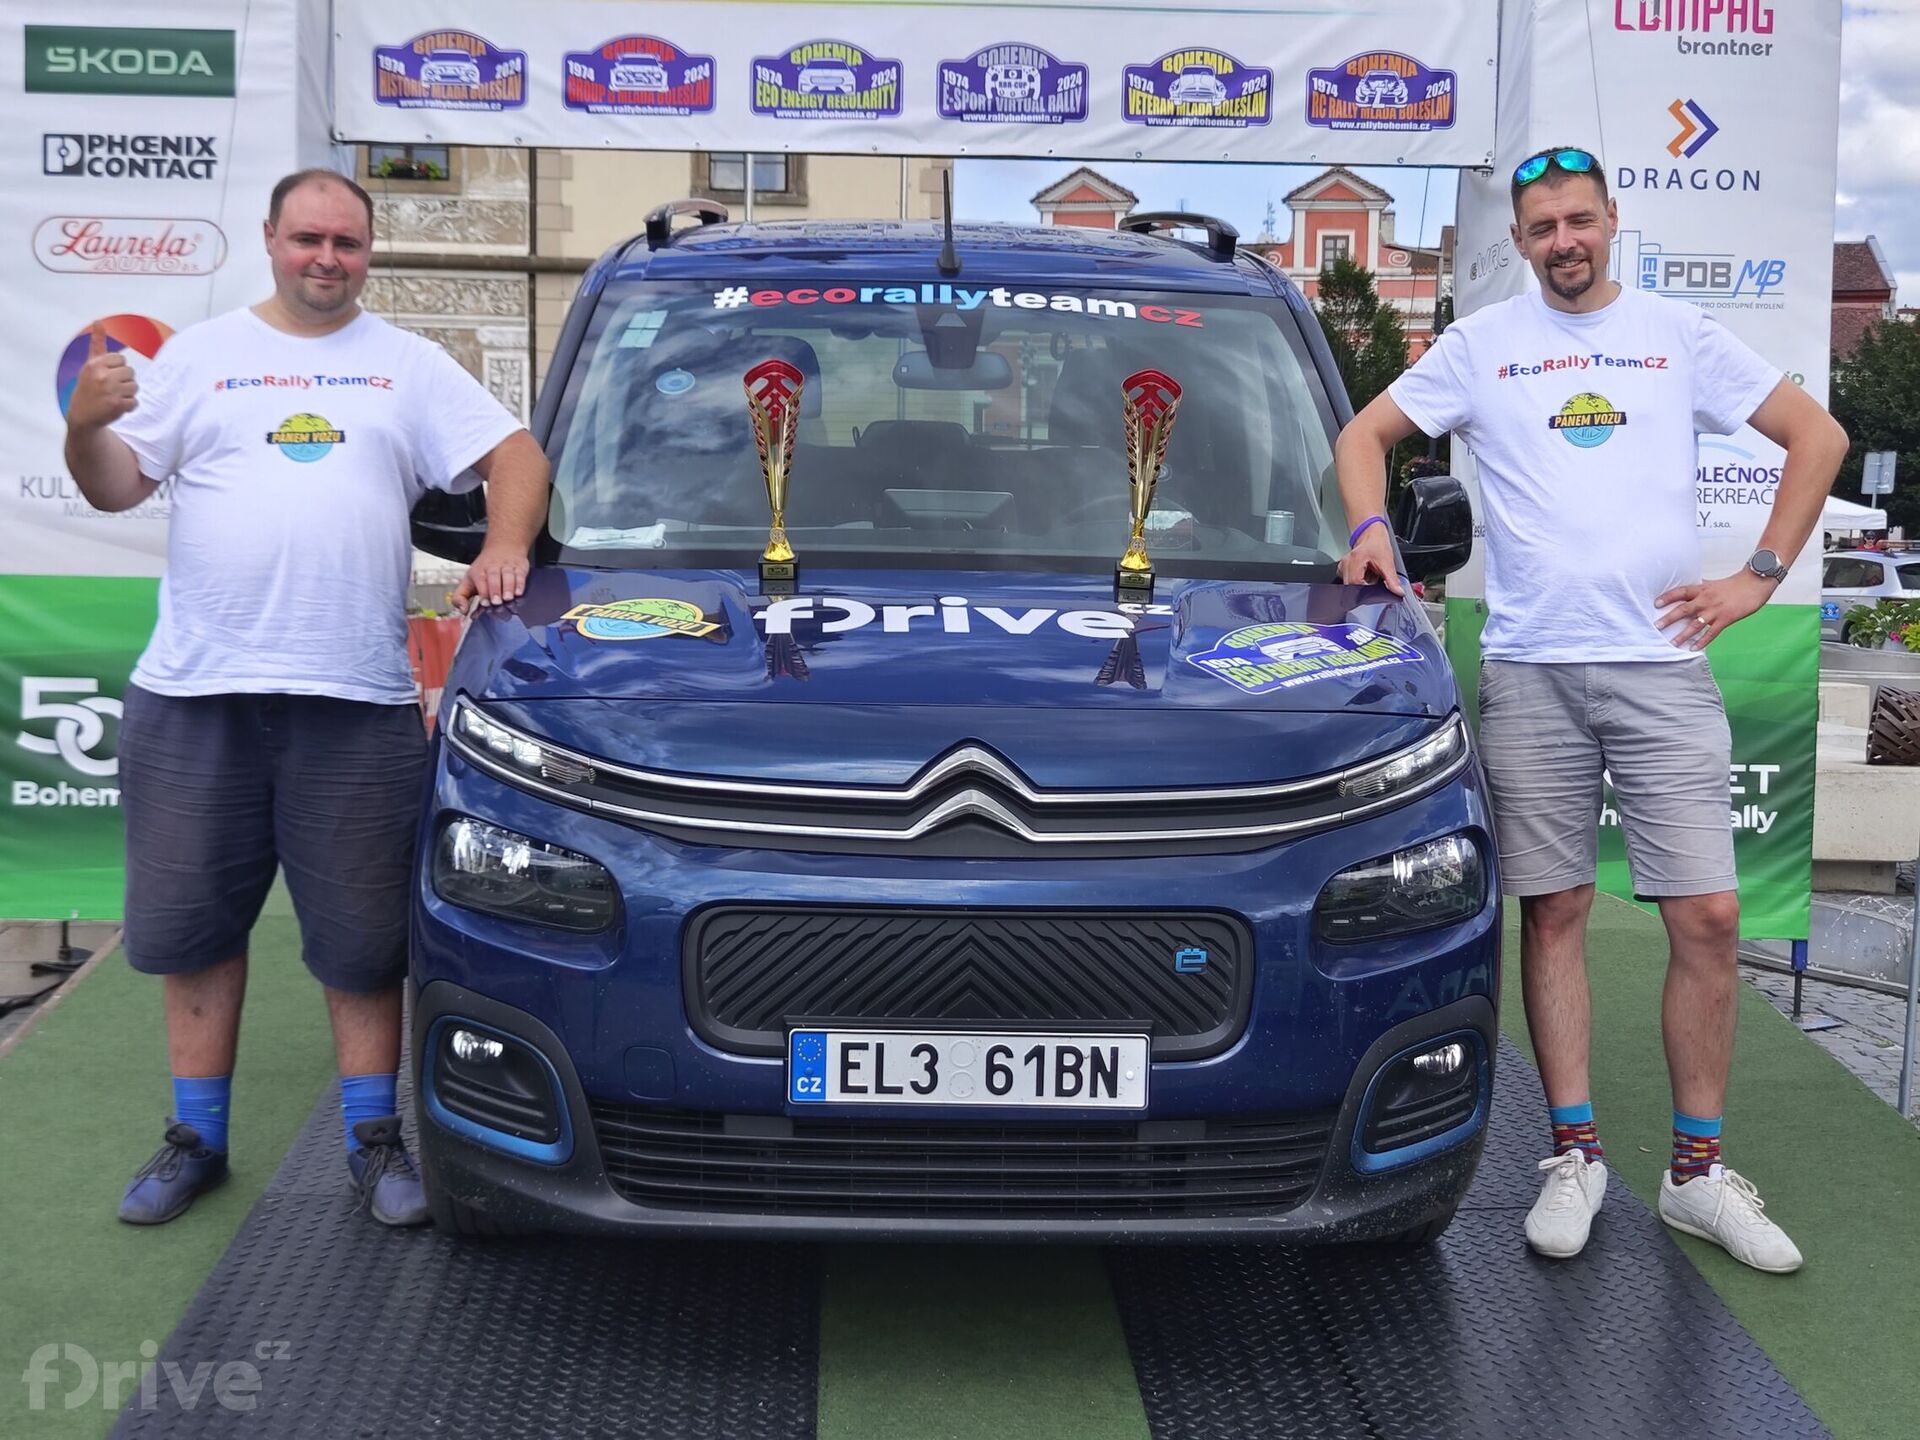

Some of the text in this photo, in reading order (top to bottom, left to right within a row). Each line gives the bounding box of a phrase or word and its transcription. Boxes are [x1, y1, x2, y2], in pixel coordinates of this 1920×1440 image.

[413, 33, 487, 56] BOHEMIA
[603, 38, 676, 62] BOHEMIA
[790, 43, 863, 66] BOHEMIA
[1677, 35, 1773, 56] brantner
[977, 46, 1049, 69] BOHEMIA
[1162, 51, 1234, 75] BOHEMIA
[1346, 54, 1418, 78] BOHEMIA
[756, 65, 783, 86] 1974
[871, 67, 897, 88] 2024
[942, 69, 969, 90] 1974
[1057, 71, 1082, 92] 2024
[1128, 73, 1154, 94] 1974
[1241, 74, 1267, 96] 2024
[568, 75, 605, 103] GROUP
[756, 81, 897, 110] ECO ENERGY REGULARITY
[943, 83, 1082, 113] E-SPORT VIRTUAL RALLY
[1312, 77, 1338, 98] 1974
[1425, 78, 1451, 99] 2024
[1128, 86, 1175, 116] VETERAN
[1214, 90, 1267, 118] BOLESLAV
[1311, 90, 1326, 119] RC
[1328, 96, 1359, 119] RALLY
[1398, 93, 1451, 120] BOLESLAV
[776, 110, 877, 119] www.rallybohemia.cz
[962, 113, 1063, 123] www.rallybohemia.cz
[1147, 117, 1247, 127] www.rallybohemia.cz
[1331, 121, 1430, 130] www.rallybohemia.cz
[87, 157, 218, 179] CONTACT
[1617, 167, 1760, 191] DRAGON
[713, 284, 1204, 328] #ecorallyteamcz
[1497, 354, 1669, 379] #EcoRallyTeamCZ
[214, 375, 394, 392] #EcoRallyTeamCZ
[1593, 413, 1622, 425] VOZU
[1224, 624, 1319, 649] BOHEMIA
[1198, 656, 1253, 670] 1974
[1215, 664, 1273, 688] ECO
[1259, 656, 1328, 678] ENERGY
[1280, 657, 1403, 688] www.rallybohemia.cz
[839, 1041, 1120, 1099] EL3 61BN
[796, 1077, 822, 1093] CZ
